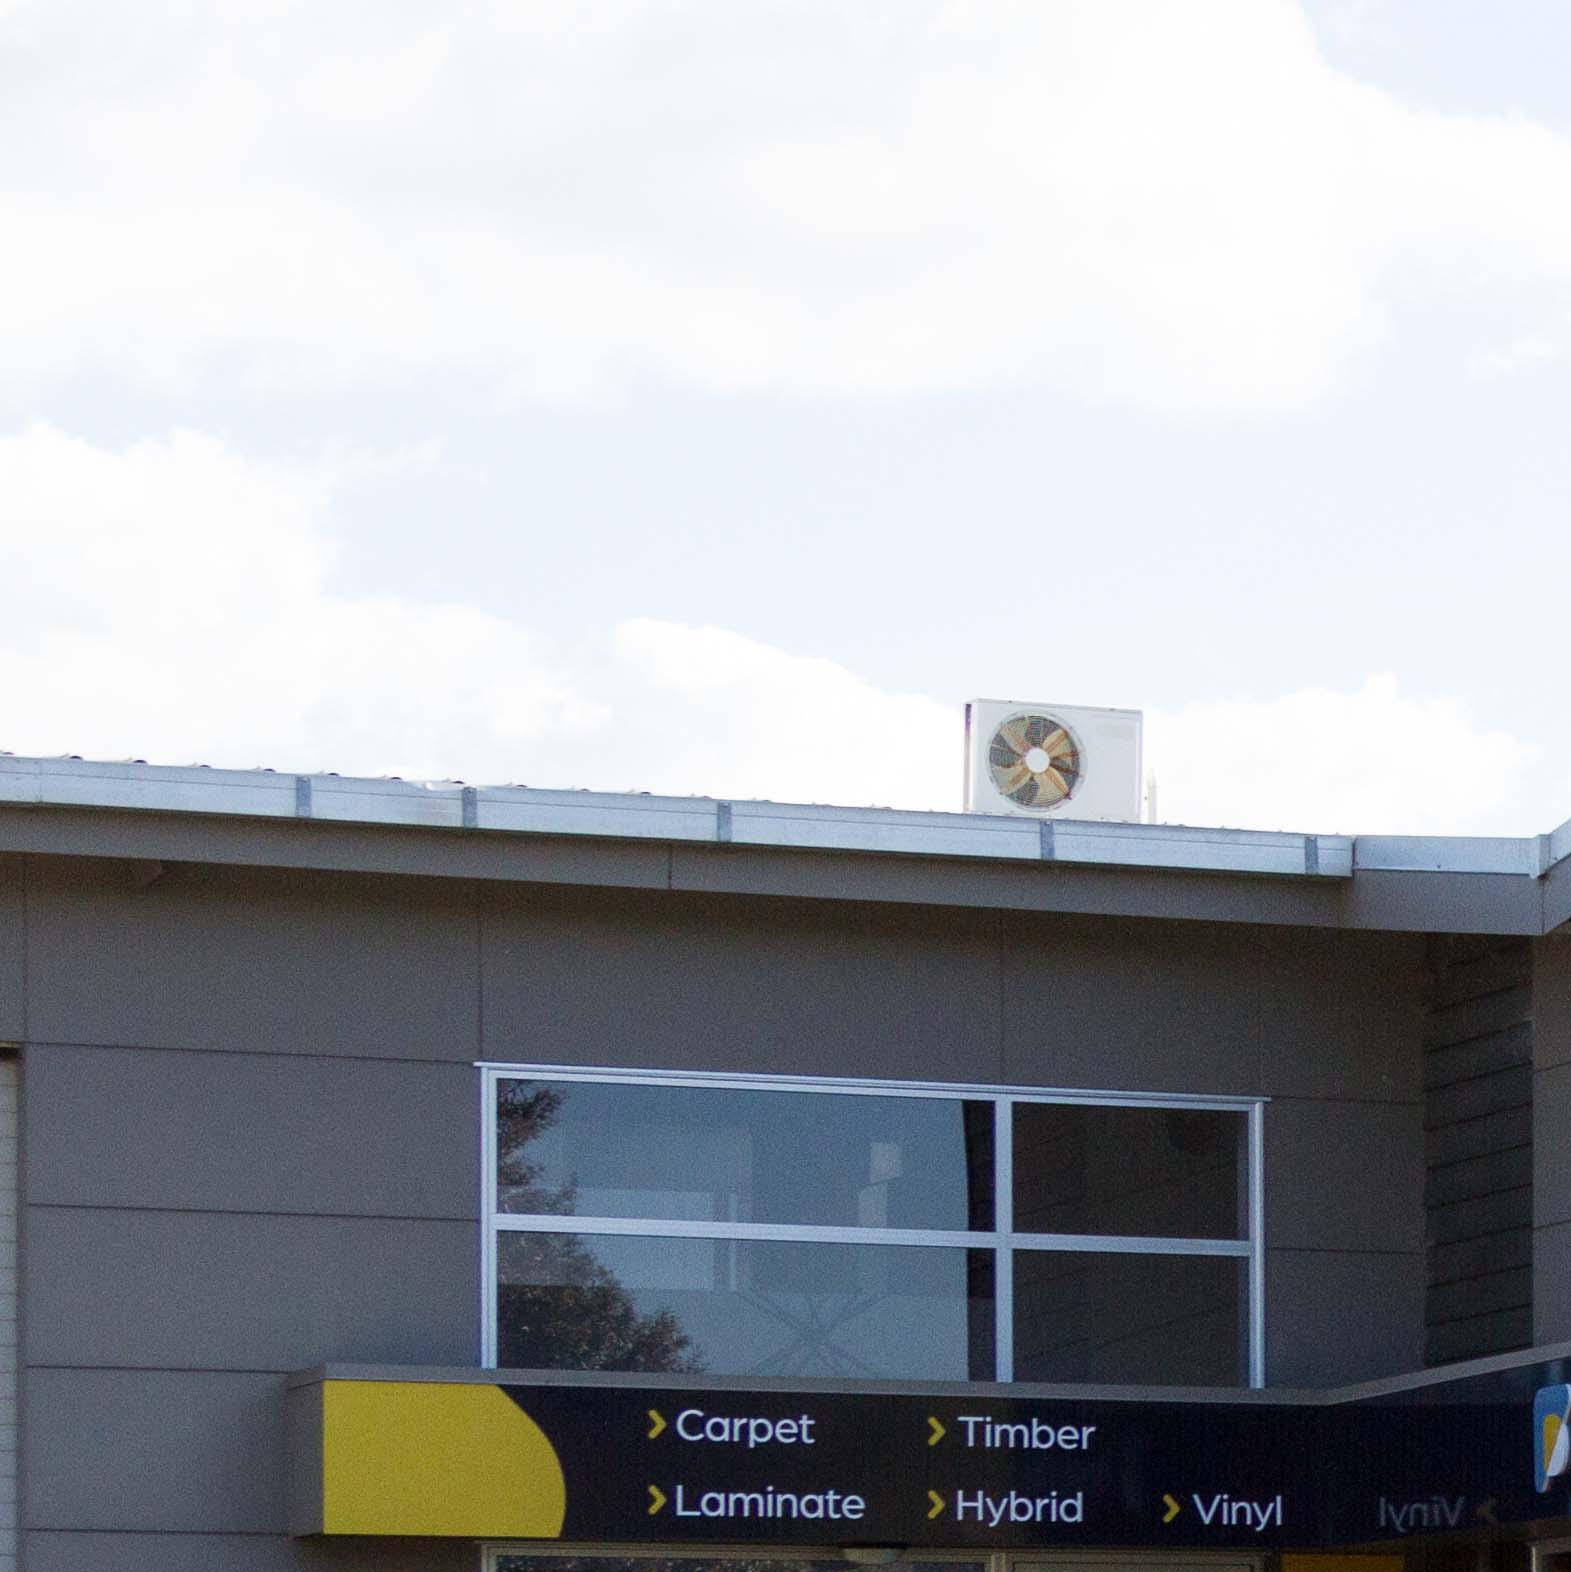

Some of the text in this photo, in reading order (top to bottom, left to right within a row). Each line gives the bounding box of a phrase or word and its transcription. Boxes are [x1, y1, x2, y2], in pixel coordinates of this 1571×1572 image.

[676, 1409, 816, 1449] Carpet
[957, 1415, 1096, 1450] Timber
[675, 1484, 866, 1520] Laminate
[956, 1490, 1084, 1528] Hybrid
[1193, 1493, 1283, 1532] Vinyl
